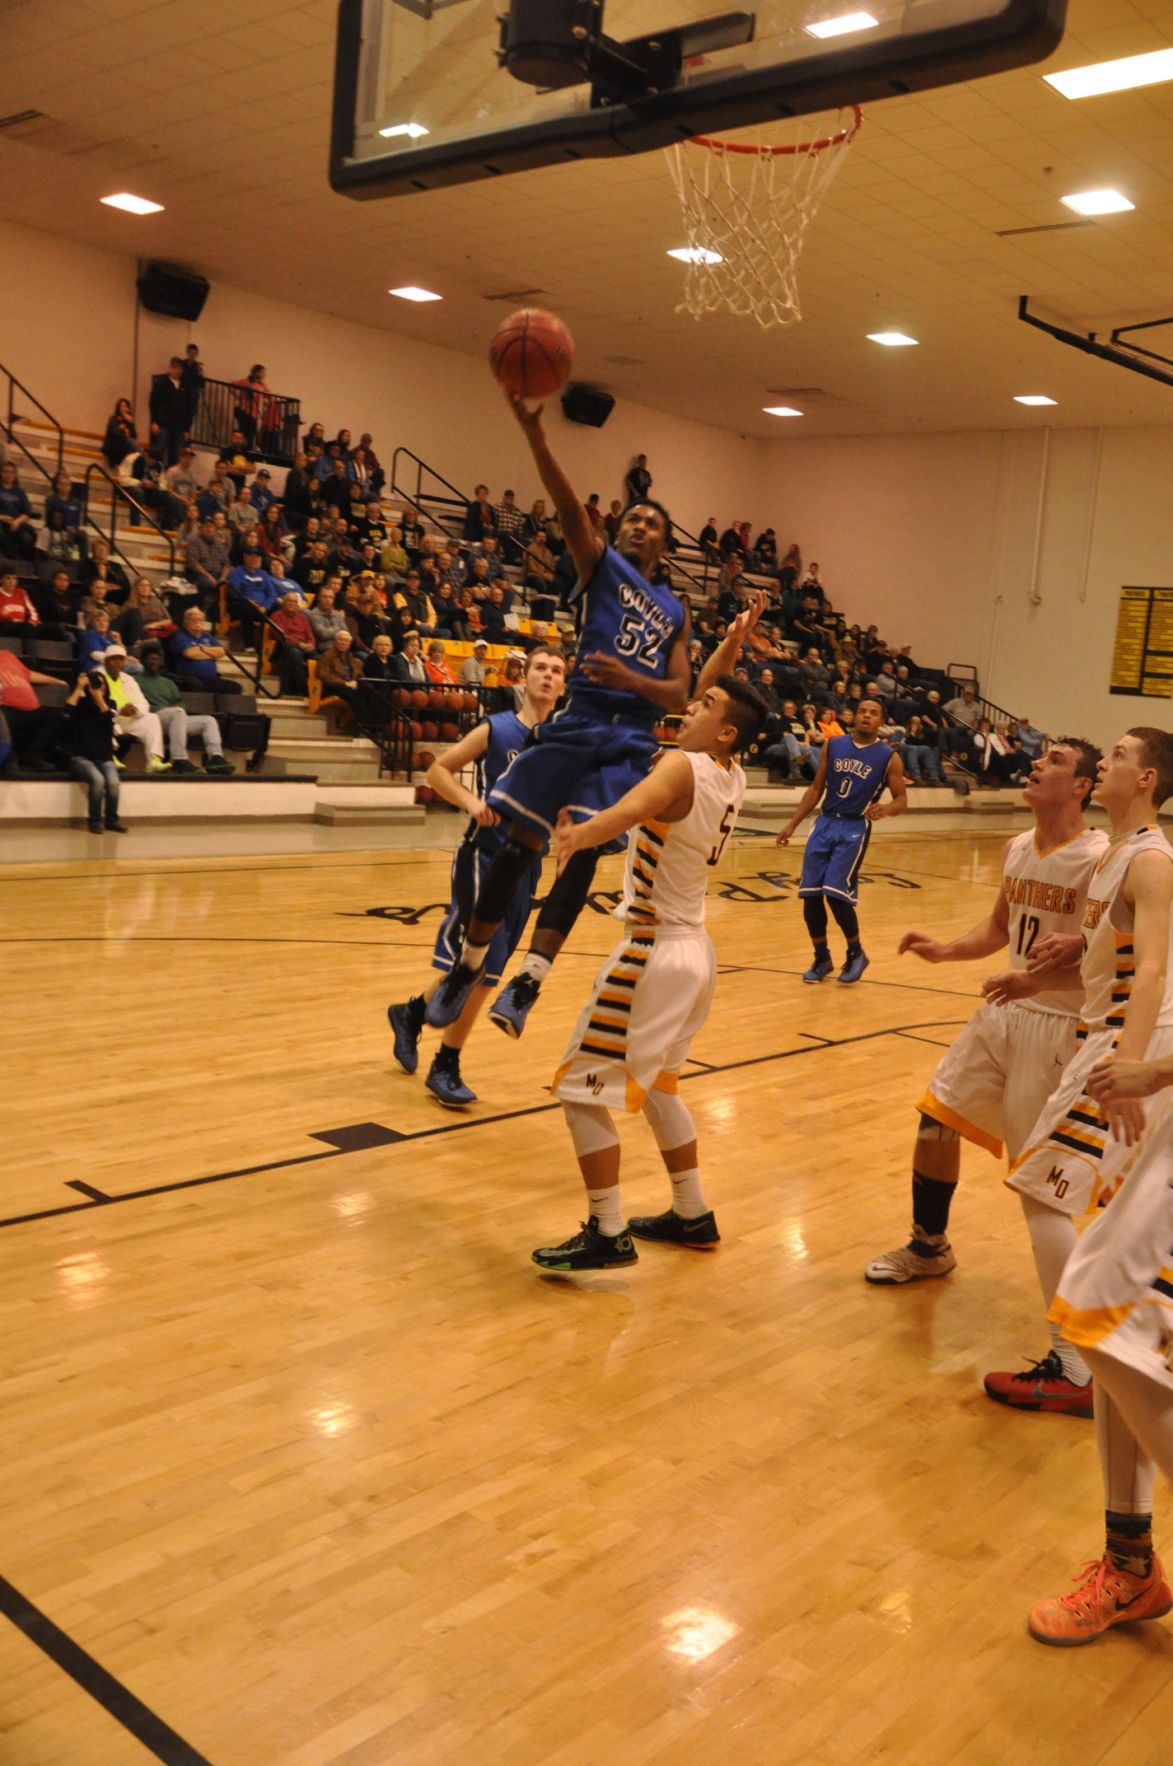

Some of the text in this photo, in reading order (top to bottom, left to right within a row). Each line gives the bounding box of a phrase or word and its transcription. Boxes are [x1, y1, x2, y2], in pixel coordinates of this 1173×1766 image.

[613, 613, 661, 670] 52
[834, 758, 873, 780] COYLE
[836, 776, 853, 799] 0
[1004, 875, 1077, 915] PANTHERS
[1016, 913, 1040, 960] 12
